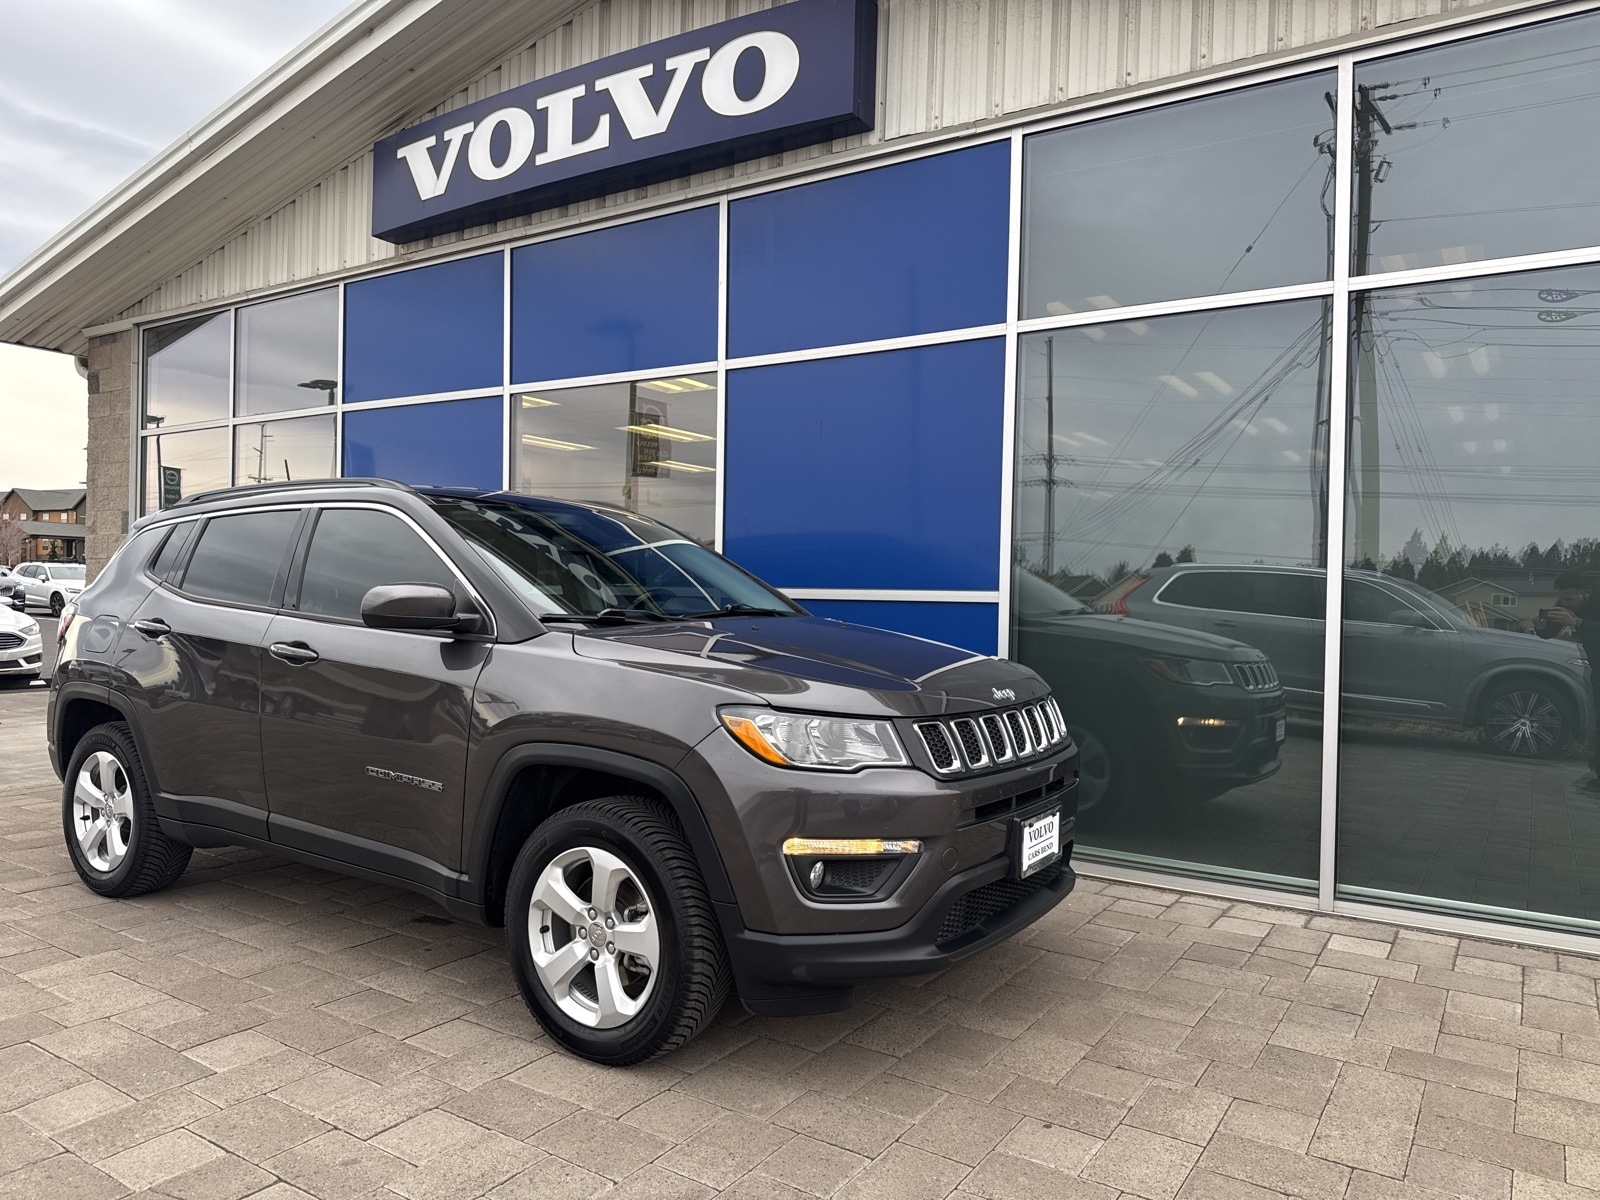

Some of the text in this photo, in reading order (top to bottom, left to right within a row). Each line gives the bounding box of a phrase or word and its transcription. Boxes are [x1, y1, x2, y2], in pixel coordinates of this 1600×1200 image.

[397, 31, 800, 201] VOLVO
[991, 687, 1016, 701] Jeep
[365, 766, 444, 792] COMPASS
[1029, 821, 1054, 843] VOLVO
[1028, 842, 1054, 861] CARS BEND
